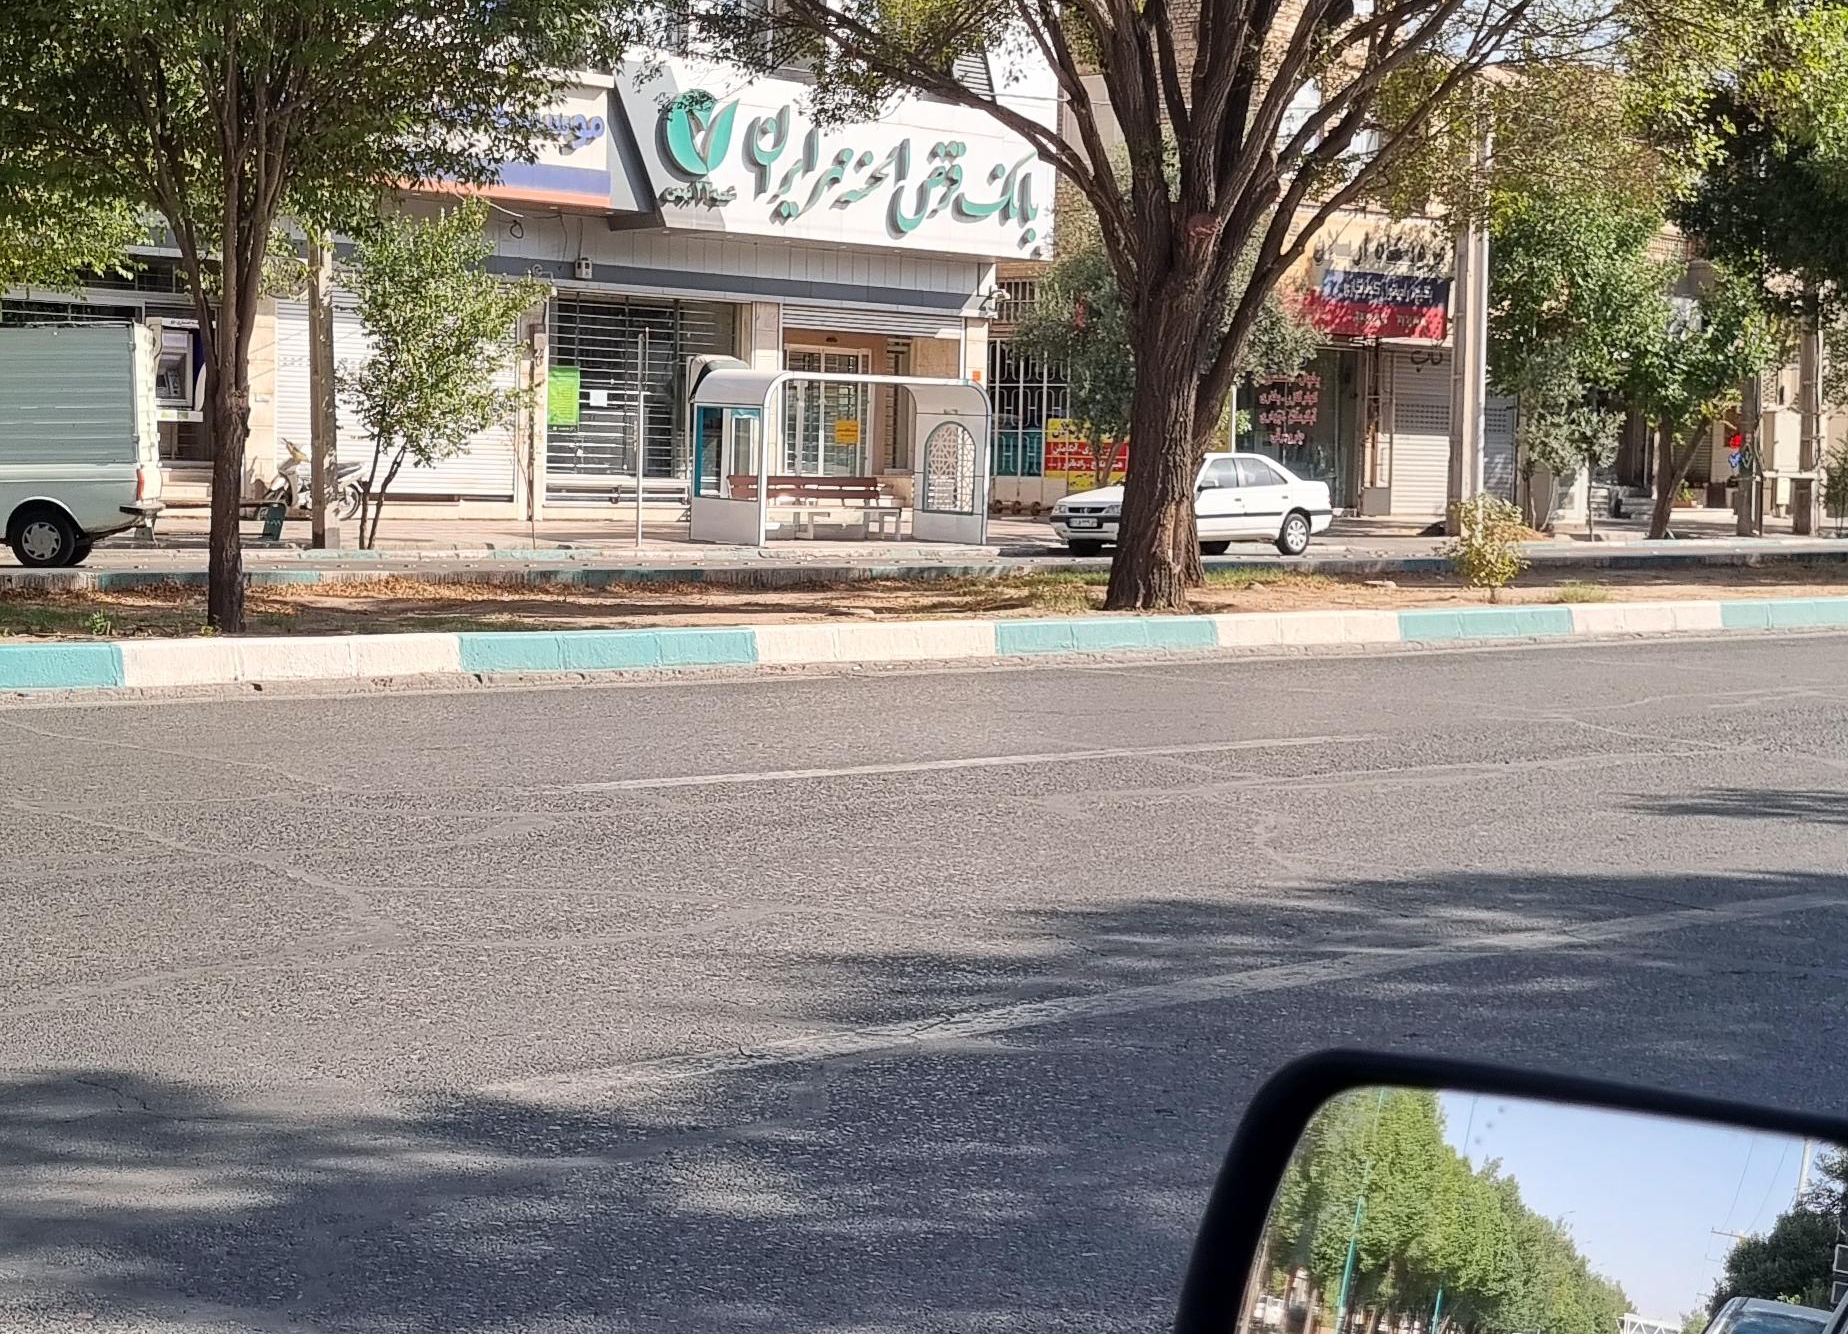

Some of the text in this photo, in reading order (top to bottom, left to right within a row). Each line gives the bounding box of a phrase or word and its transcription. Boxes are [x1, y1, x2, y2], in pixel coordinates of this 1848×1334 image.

[742, 104, 820, 226] ایران
[887, 140, 967, 240] قرض
[952, 151, 1039, 250] بانک
